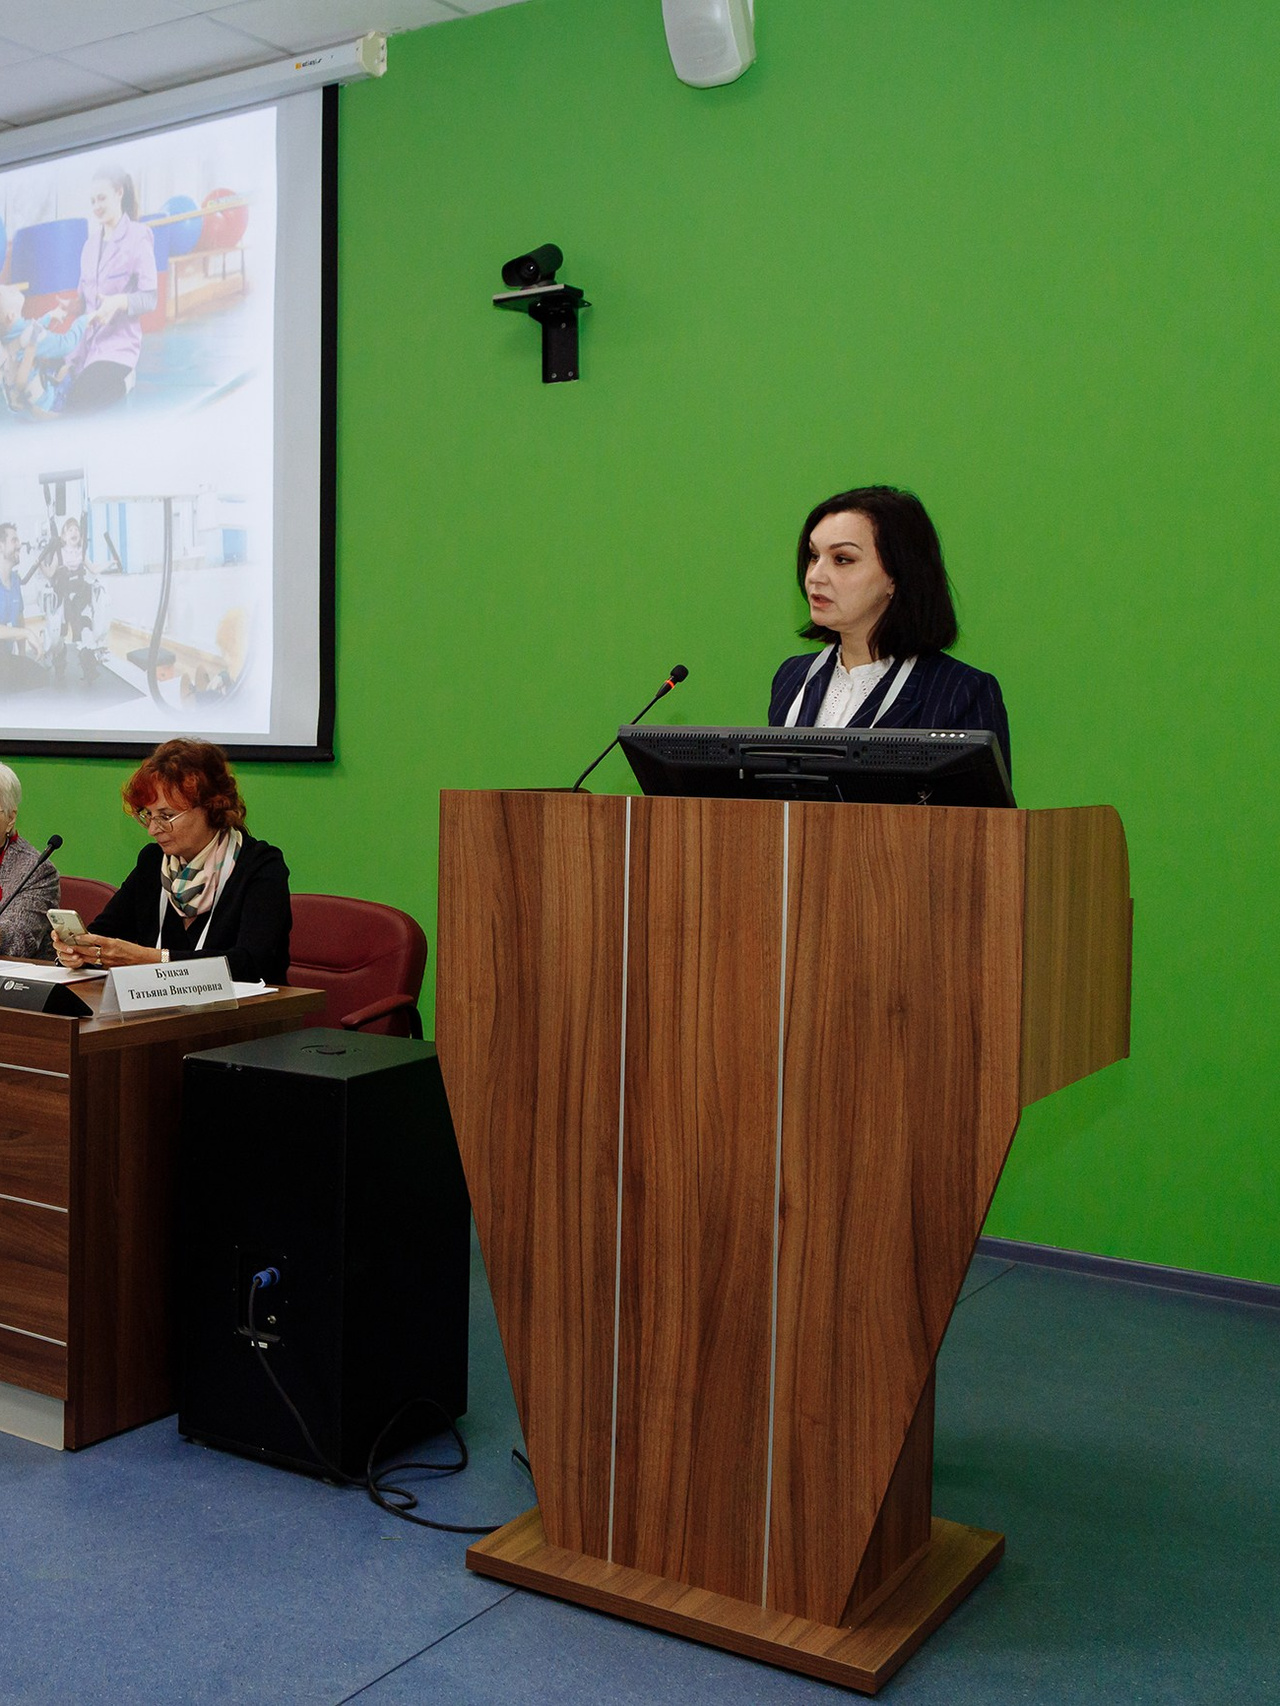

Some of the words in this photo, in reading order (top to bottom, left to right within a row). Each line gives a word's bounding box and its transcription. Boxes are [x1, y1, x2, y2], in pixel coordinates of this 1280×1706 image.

[155, 967, 190, 981] Буцкая
[128, 988, 168, 1000] Татьяна
[168, 982, 223, 996] Викторовна
